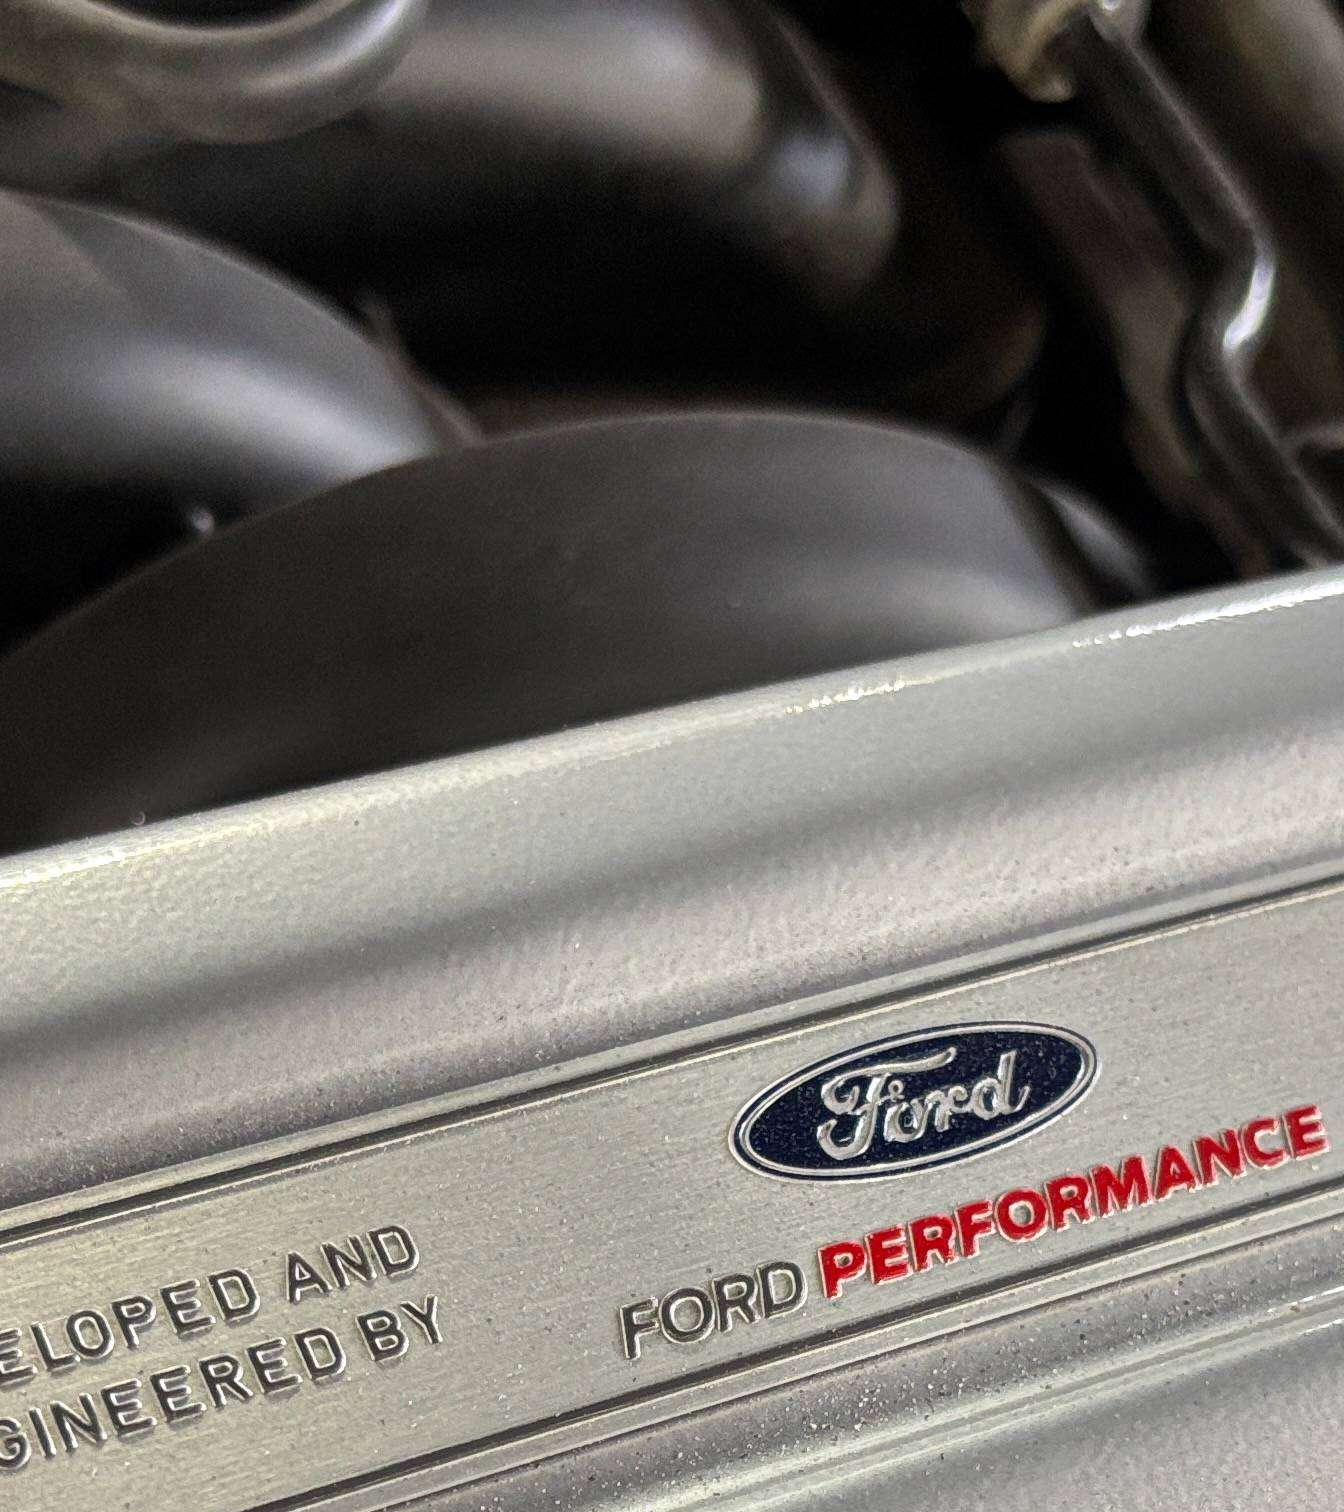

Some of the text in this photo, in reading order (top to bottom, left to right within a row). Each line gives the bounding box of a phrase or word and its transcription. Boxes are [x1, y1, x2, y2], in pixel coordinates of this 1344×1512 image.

[816, 1046, 1031, 1161] Ford
[285, 1223, 421, 1303] AND
[618, 1104, 1331, 1361] FORD PERFORMANCE
[356, 1295, 446, 1364] BY
